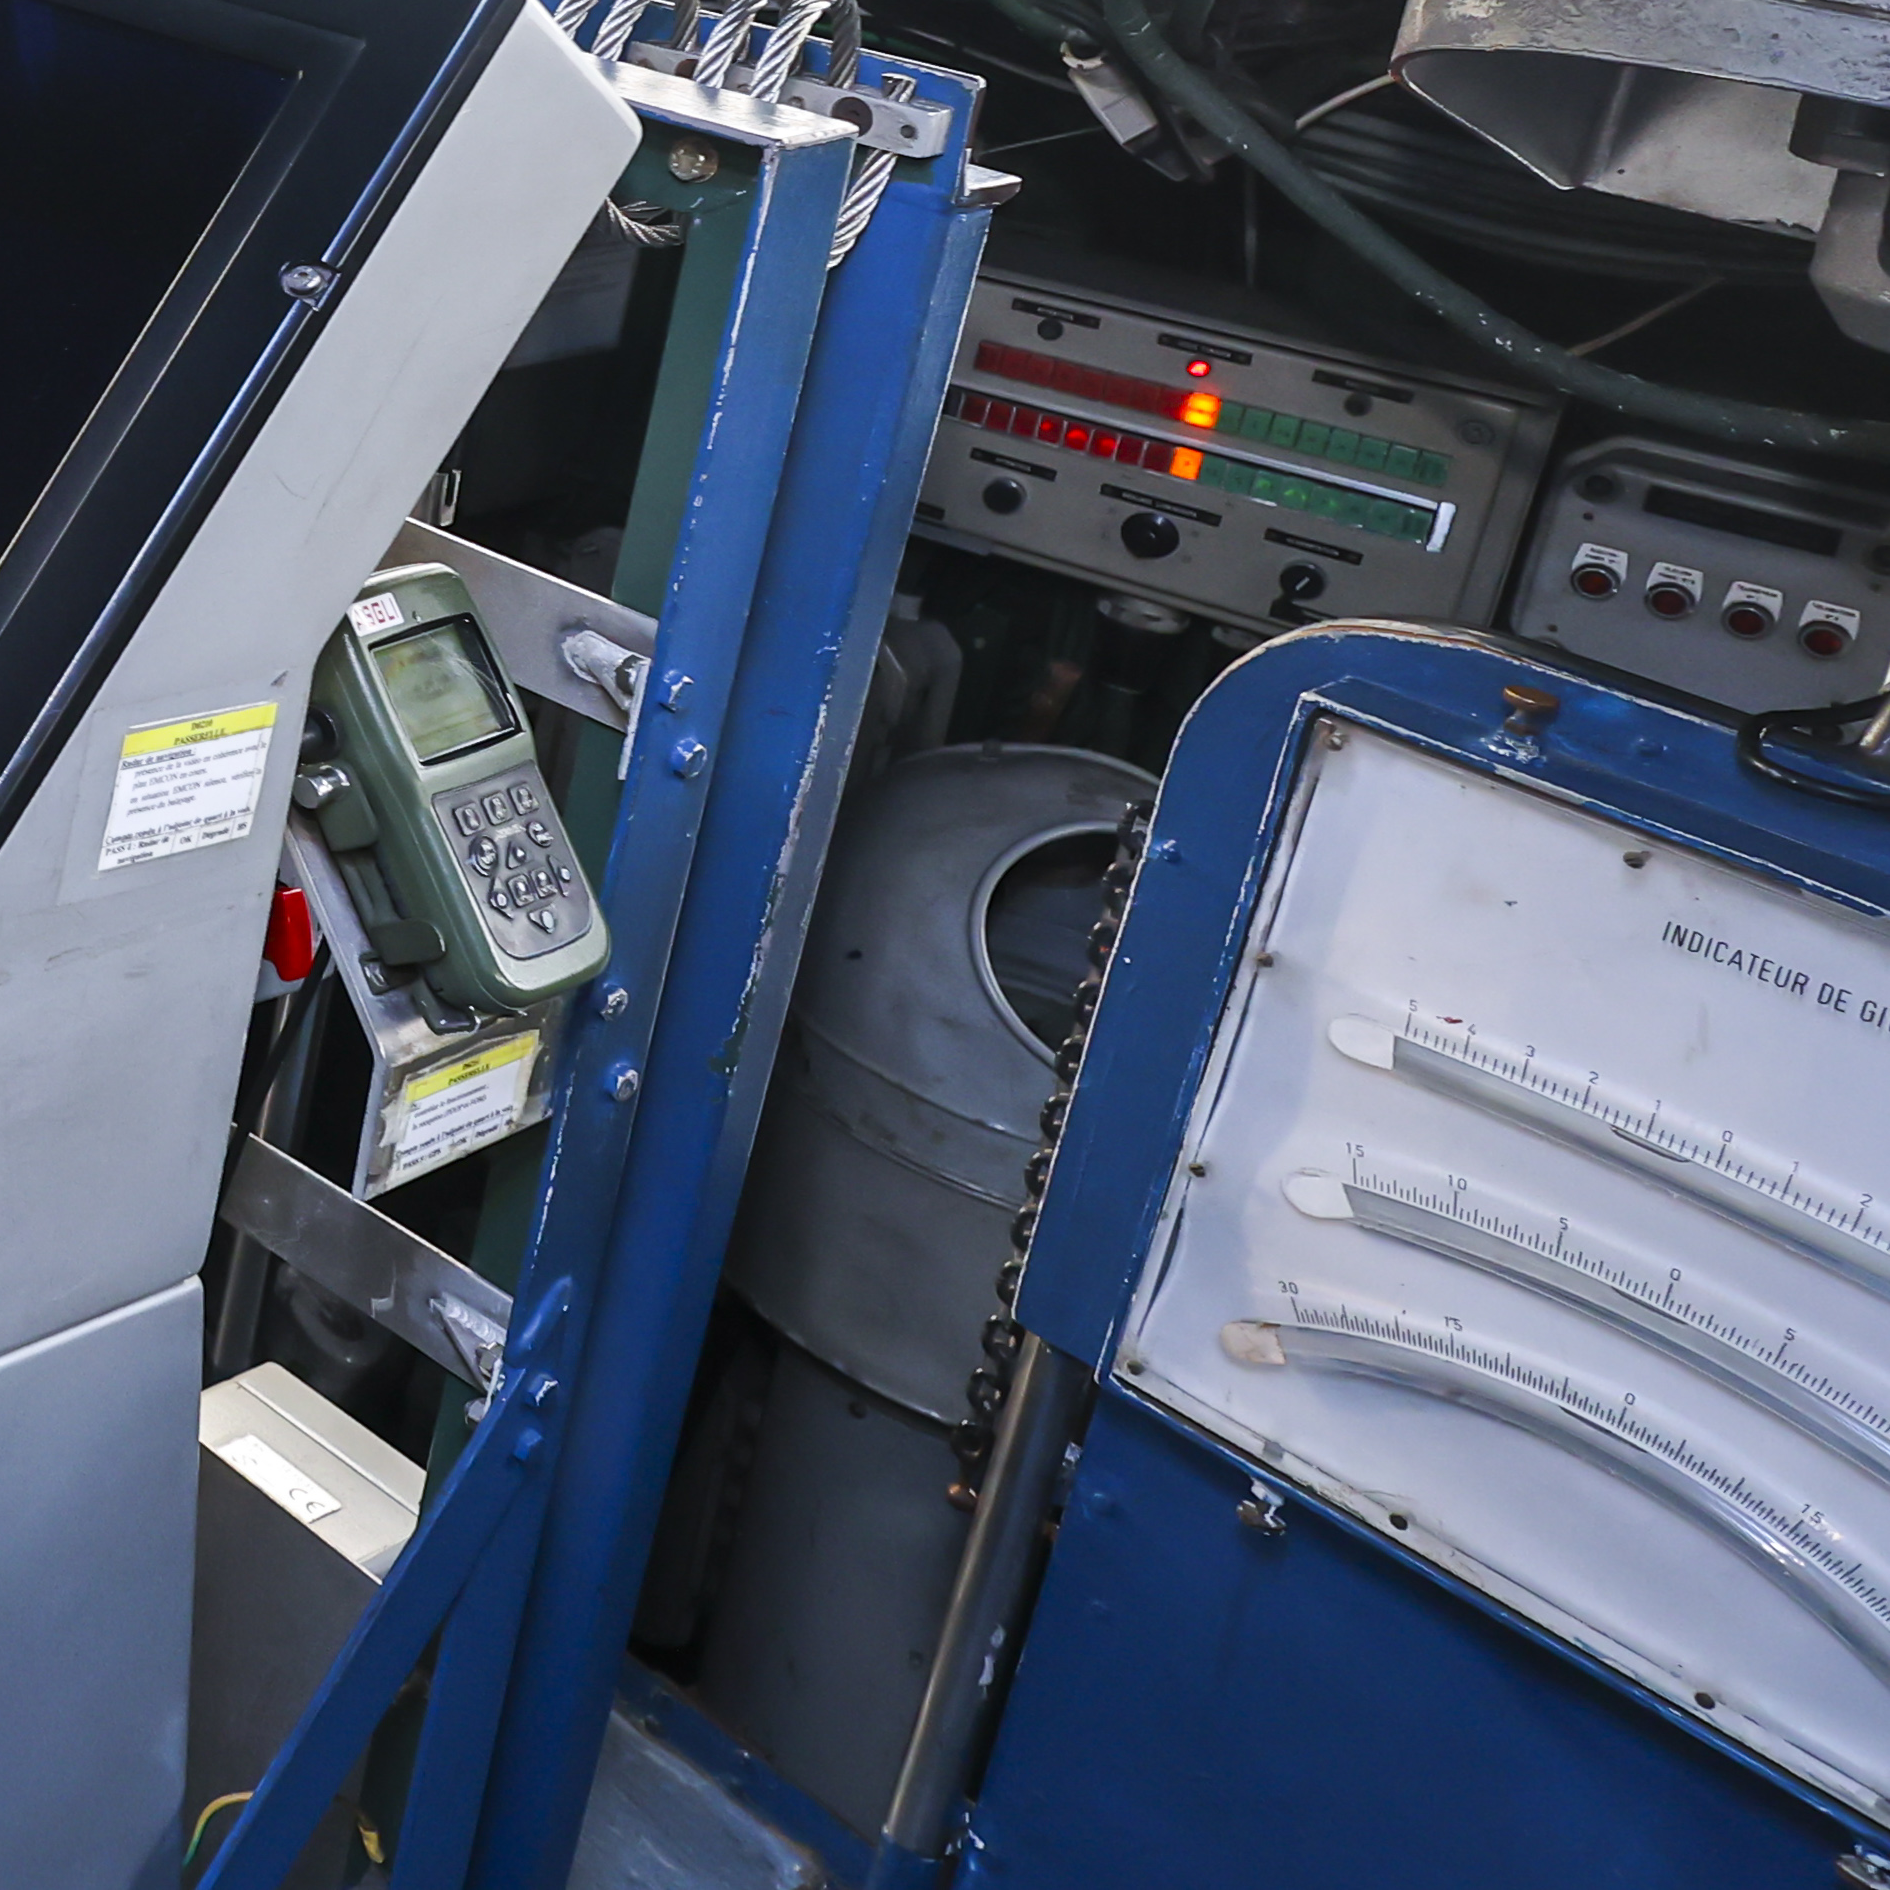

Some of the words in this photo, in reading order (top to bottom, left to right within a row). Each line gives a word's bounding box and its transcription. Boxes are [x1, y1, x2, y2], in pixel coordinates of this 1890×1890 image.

[1661, 920, 1809, 997] INDICATEUR
[1816, 982, 1852, 1014] DE
[1859, 1001, 1890, 1032] GI
[1408, 999, 1418, 1012] 5
[1466, 1024, 1477, 1036] 4
[1525, 1045, 1536, 1058] 3
[1588, 1071, 1599, 1084] 2
[1721, 1129, 1733, 1143] 0
[1860, 1193, 1873, 1207] 2
[1345, 1142, 1364, 1158] 15
[1447, 1175, 1468, 1191] 10
[1558, 1217, 1568, 1230] 5
[1669, 1268, 1682, 1282] 0
[1783, 1327, 1797, 1341] 5
[1278, 1280, 1299, 1296] 30
[1624, 1392, 1636, 1406] 0
[289, 1488, 325, 1514] CE
